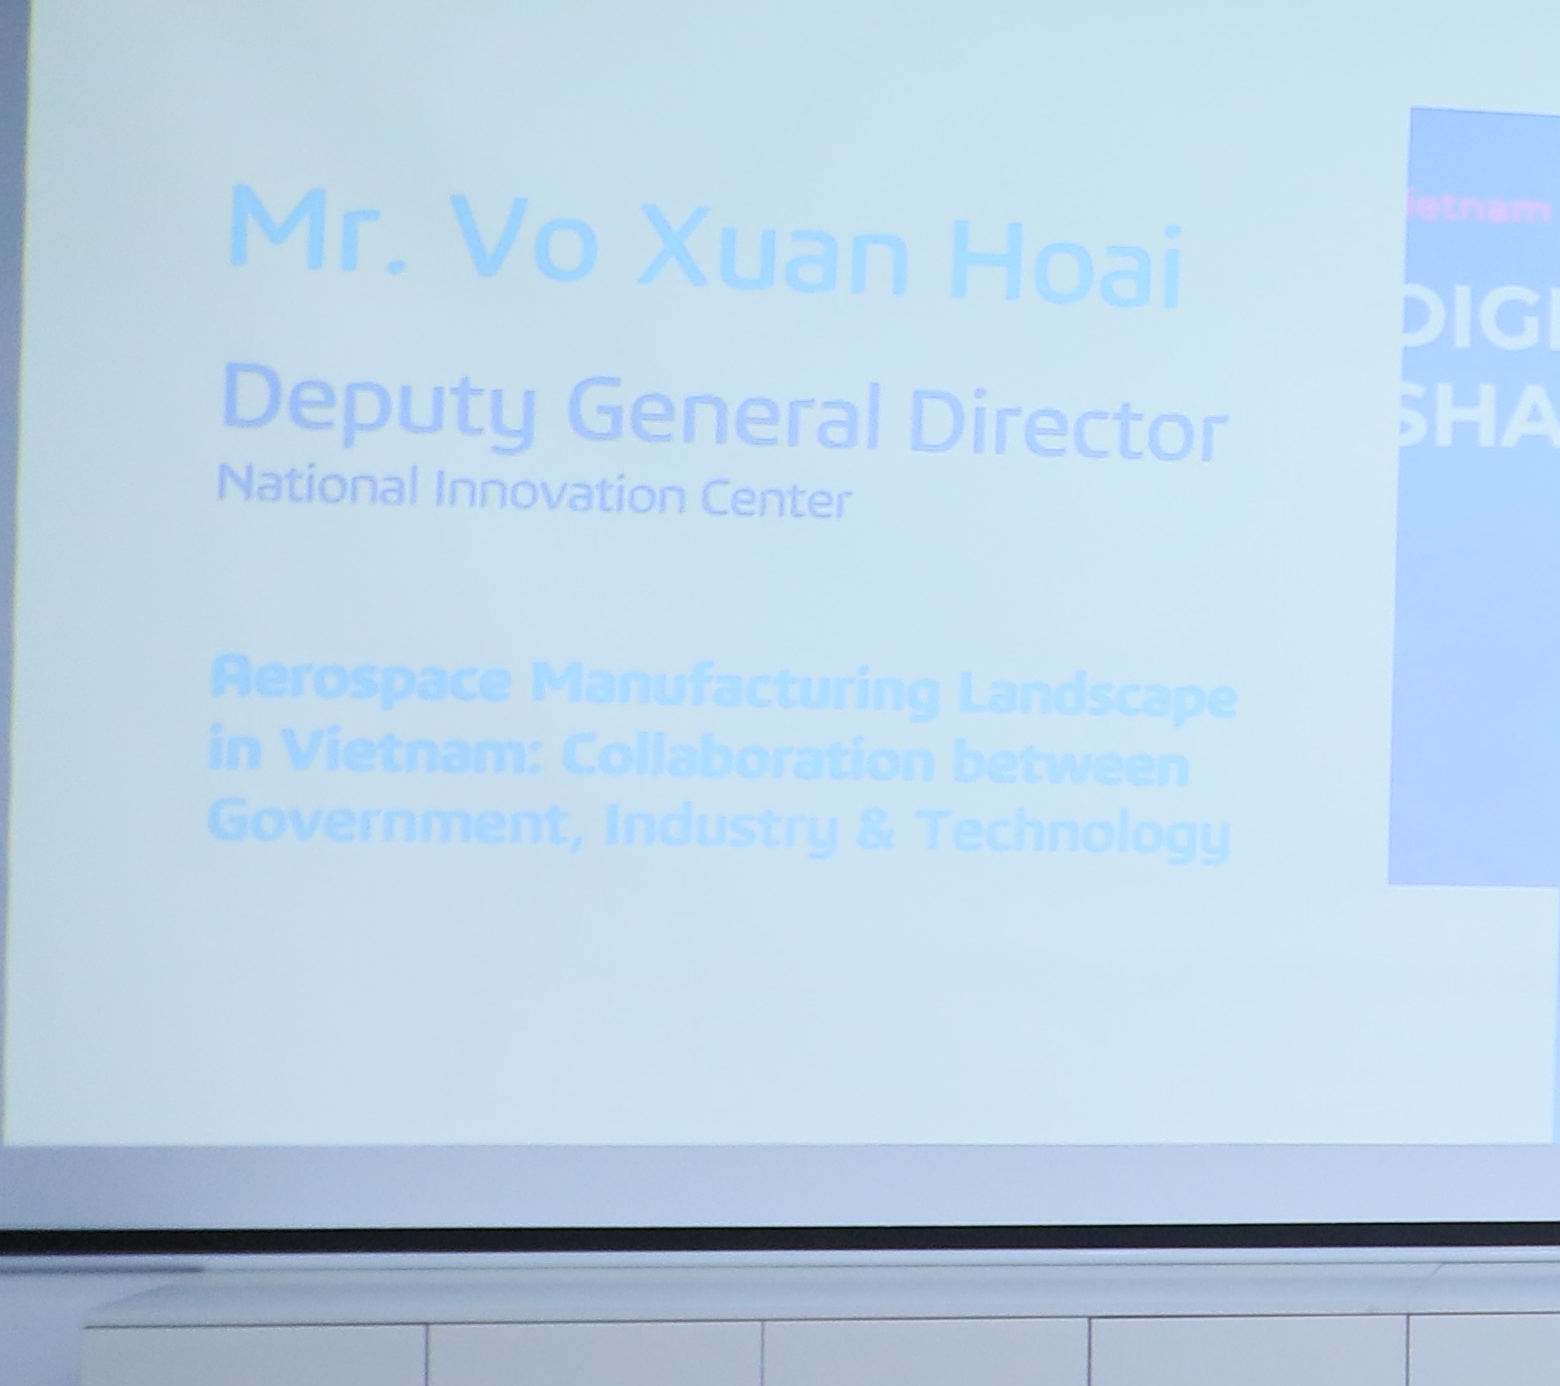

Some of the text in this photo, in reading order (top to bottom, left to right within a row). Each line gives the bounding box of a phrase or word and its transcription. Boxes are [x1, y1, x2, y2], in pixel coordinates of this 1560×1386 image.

[230, 183, 1182, 309] Mr. Vo Xuan Hoai
[223, 360, 1230, 463] Deputy General Director
[217, 461, 854, 520] National Innovation Center
[210, 652, 1239, 726] Aerospace Manufacturing Landscape
[208, 722, 1191, 787] in Vietnam: Collaboration between
[206, 796, 1231, 867] Government, Industry & Technology
